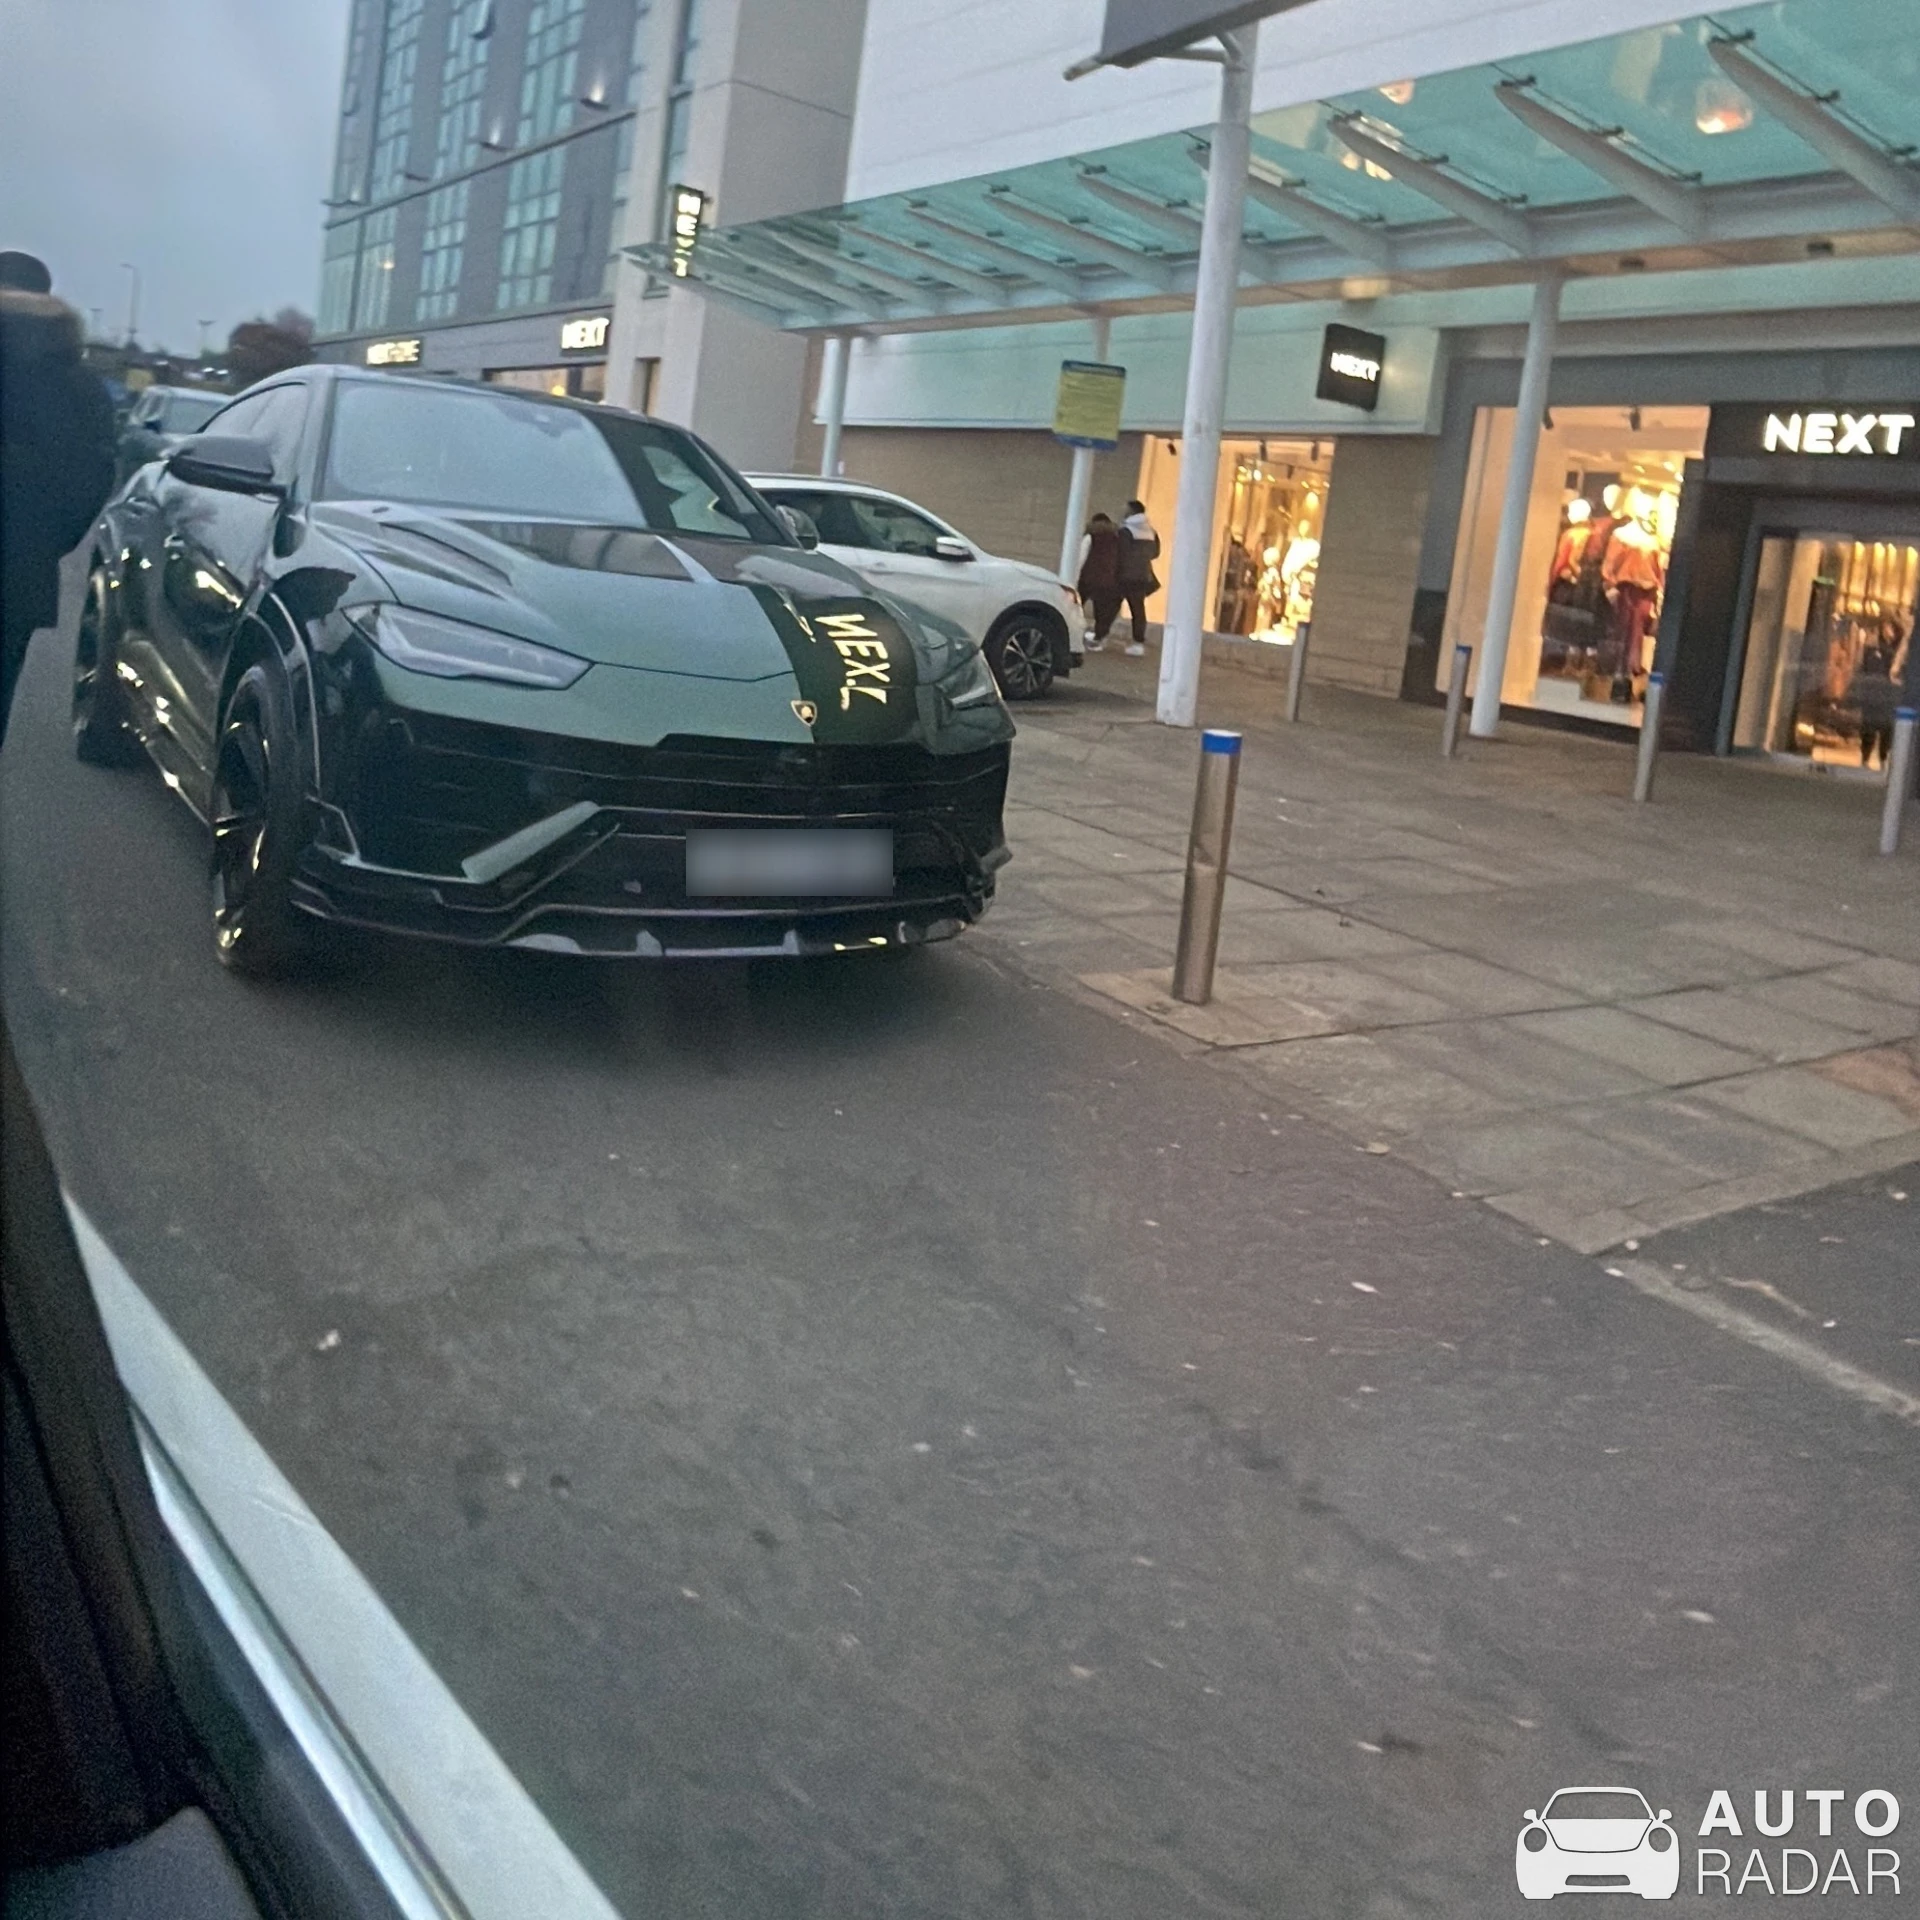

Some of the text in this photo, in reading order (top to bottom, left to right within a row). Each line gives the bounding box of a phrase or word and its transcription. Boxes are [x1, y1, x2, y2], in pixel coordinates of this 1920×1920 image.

[561, 317, 609, 349] NEXT
[1330, 352, 1380, 382] NEXT
[1763, 413, 1915, 455] NEXT
